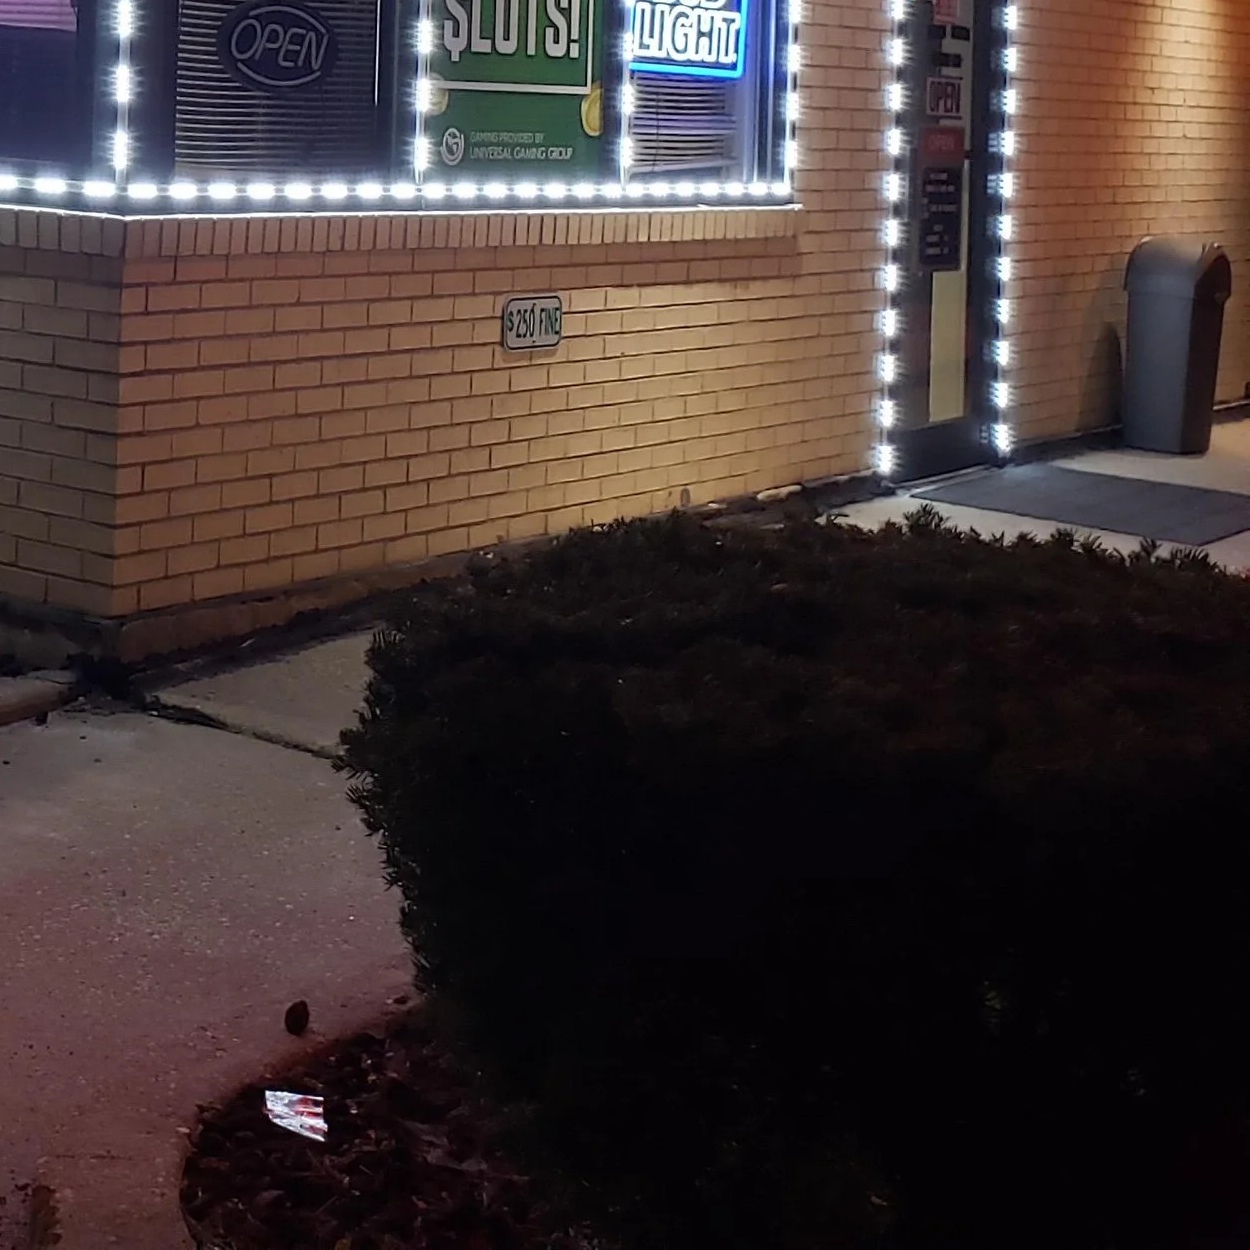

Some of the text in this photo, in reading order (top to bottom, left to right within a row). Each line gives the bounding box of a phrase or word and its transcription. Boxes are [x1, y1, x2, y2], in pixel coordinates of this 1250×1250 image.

[231, 18, 329, 71] OPEN
[633, 1, 742, 64] LIGHT
[930, 80, 961, 114] OPEN
[513, 147, 546, 159] GAMING
[539, 306, 560, 336] FINE
